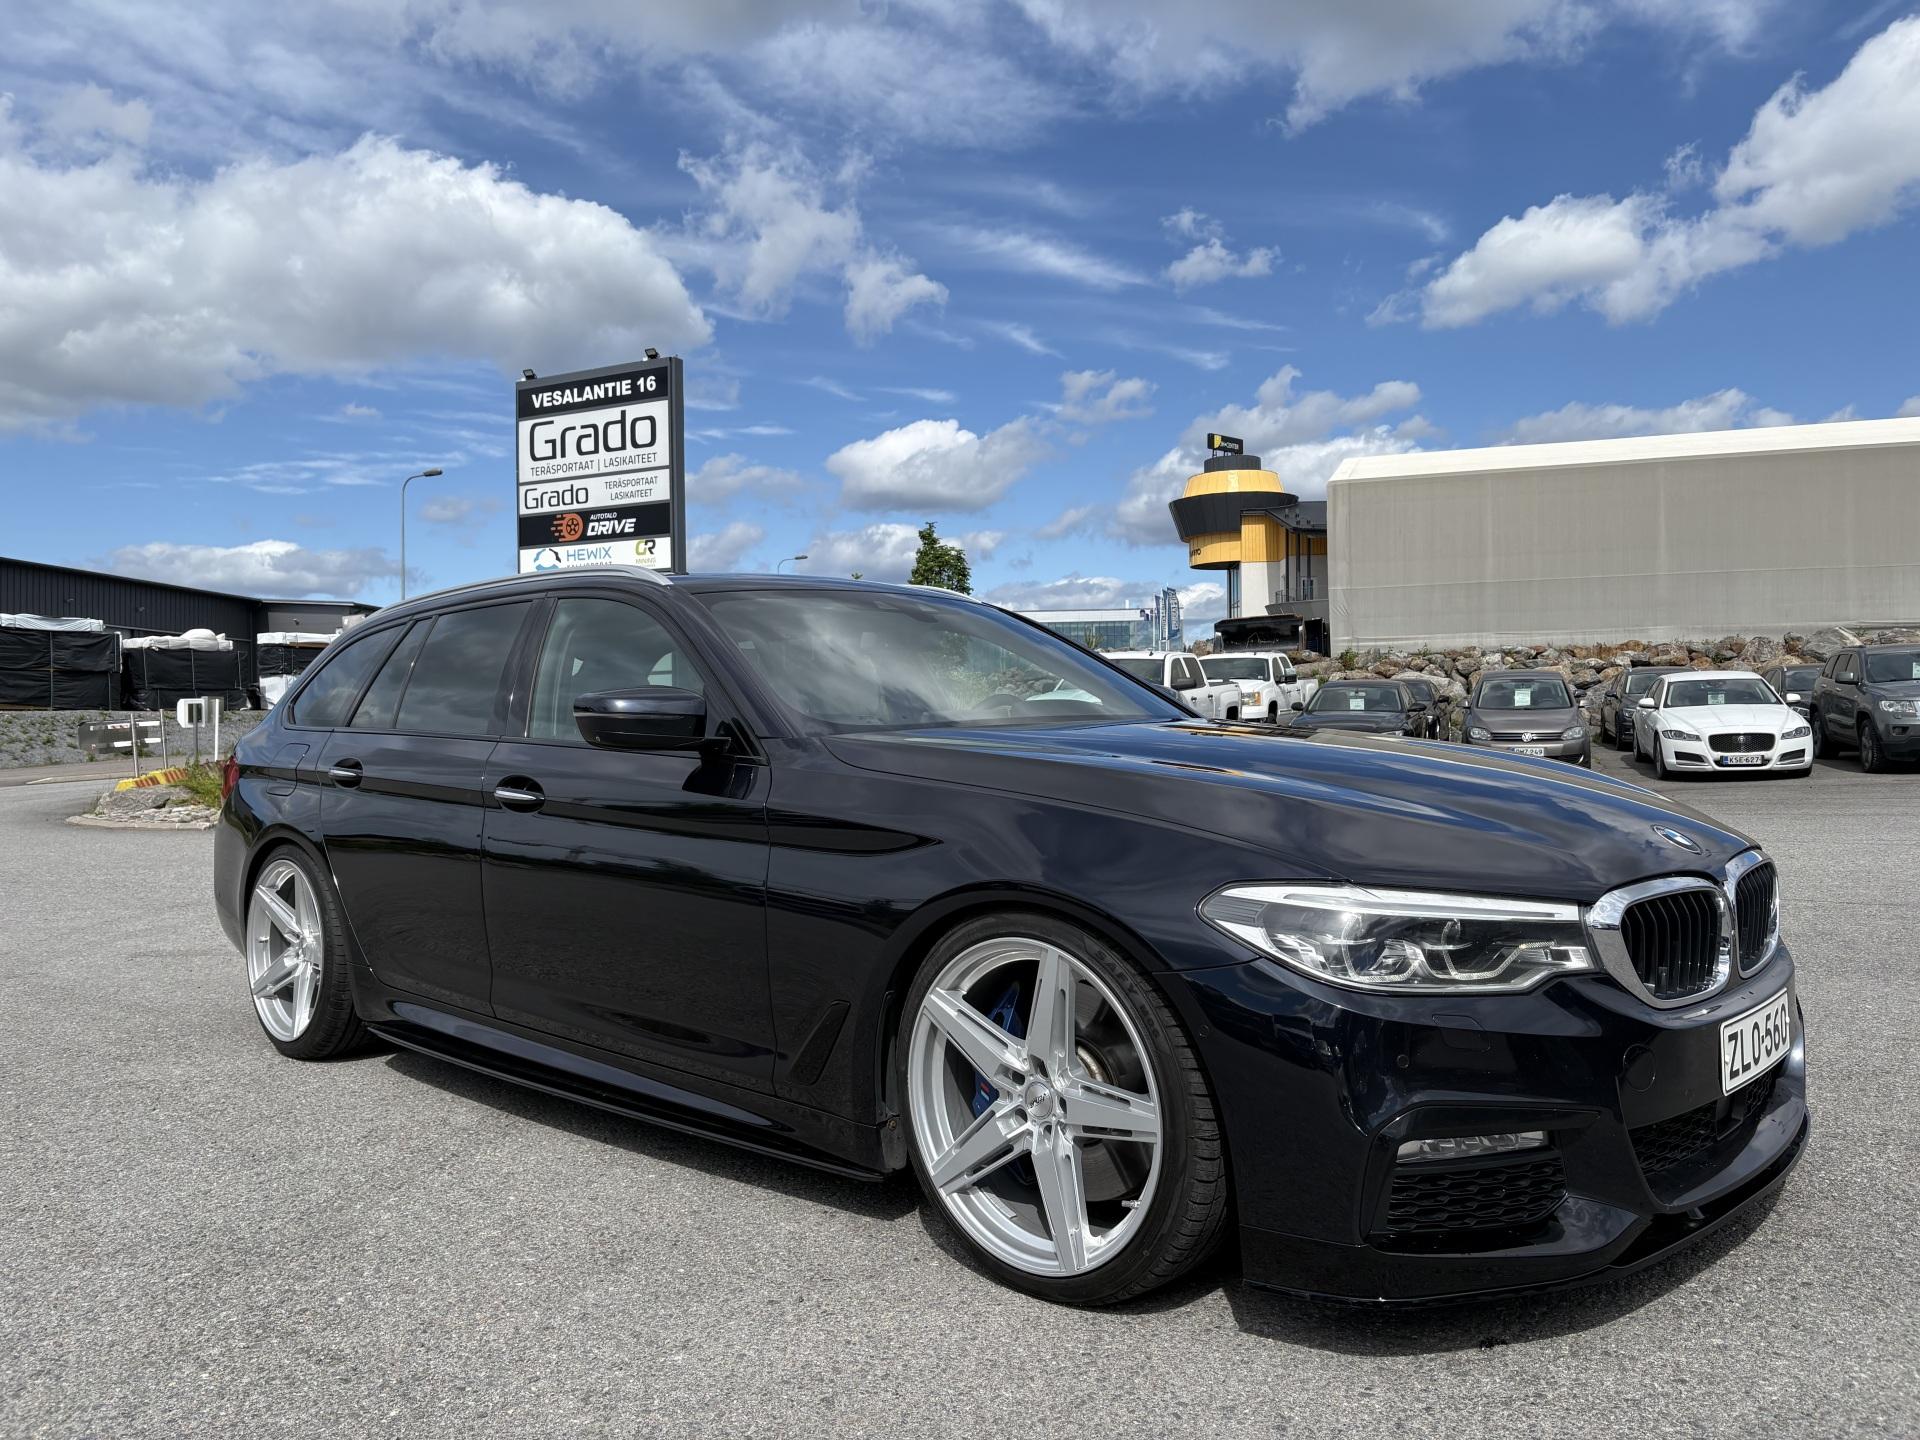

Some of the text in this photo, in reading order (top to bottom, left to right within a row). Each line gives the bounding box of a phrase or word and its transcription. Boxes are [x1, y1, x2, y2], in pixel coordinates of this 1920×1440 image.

[531, 376, 657, 408] VESALANTIE 16
[529, 409, 657, 462] Grado
[530, 452, 658, 477] TERÄSPORTAAT LASIKAITEET
[604, 475, 659, 490] TERÄSPORTAAT
[524, 484, 589, 510] Grado
[610, 489, 653, 501] LASIKAITEET
[590, 512, 618, 520] AUTOTALO
[586, 518, 637, 536] DRIVE
[566, 546, 612, 562] HEWIX
[1729, 756, 1760, 764] KSE-627
[1727, 1003, 1787, 1081] ZLO-560
